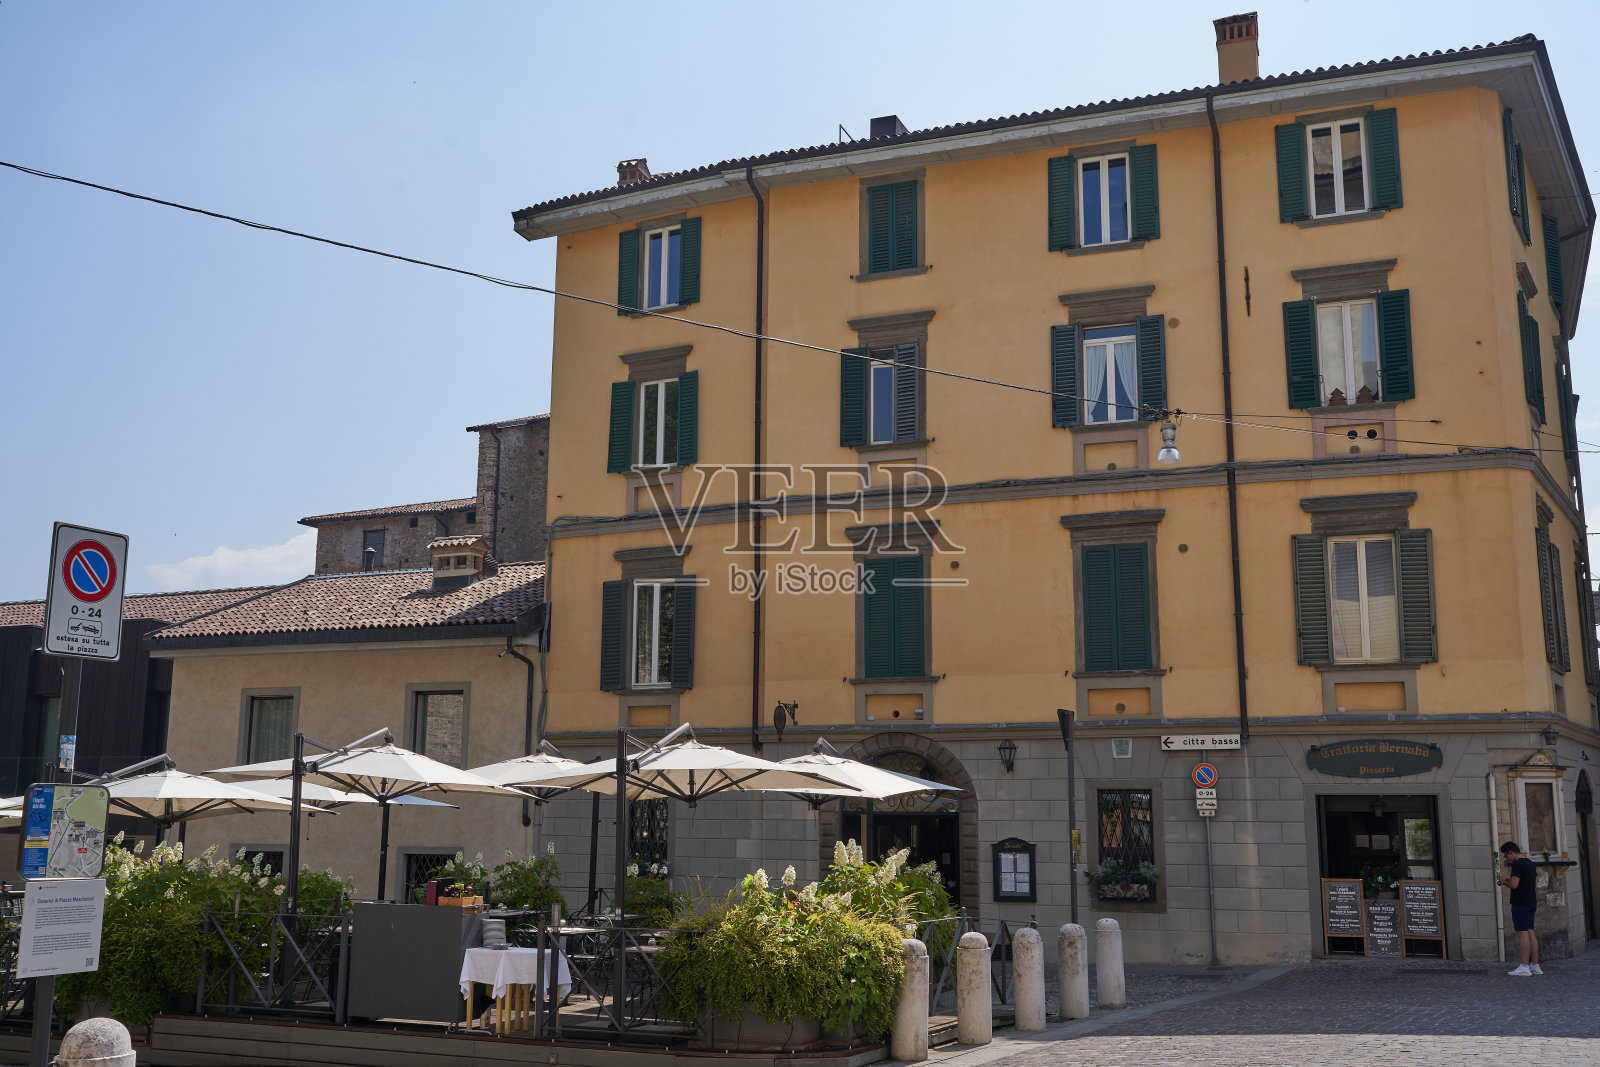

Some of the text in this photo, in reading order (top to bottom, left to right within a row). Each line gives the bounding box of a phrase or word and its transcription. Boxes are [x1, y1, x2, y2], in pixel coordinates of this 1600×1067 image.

[56, 635, 79, 643] estesa
[93, 638, 110, 647] tutta
[1320, 743, 1376, 759] Trattoria
